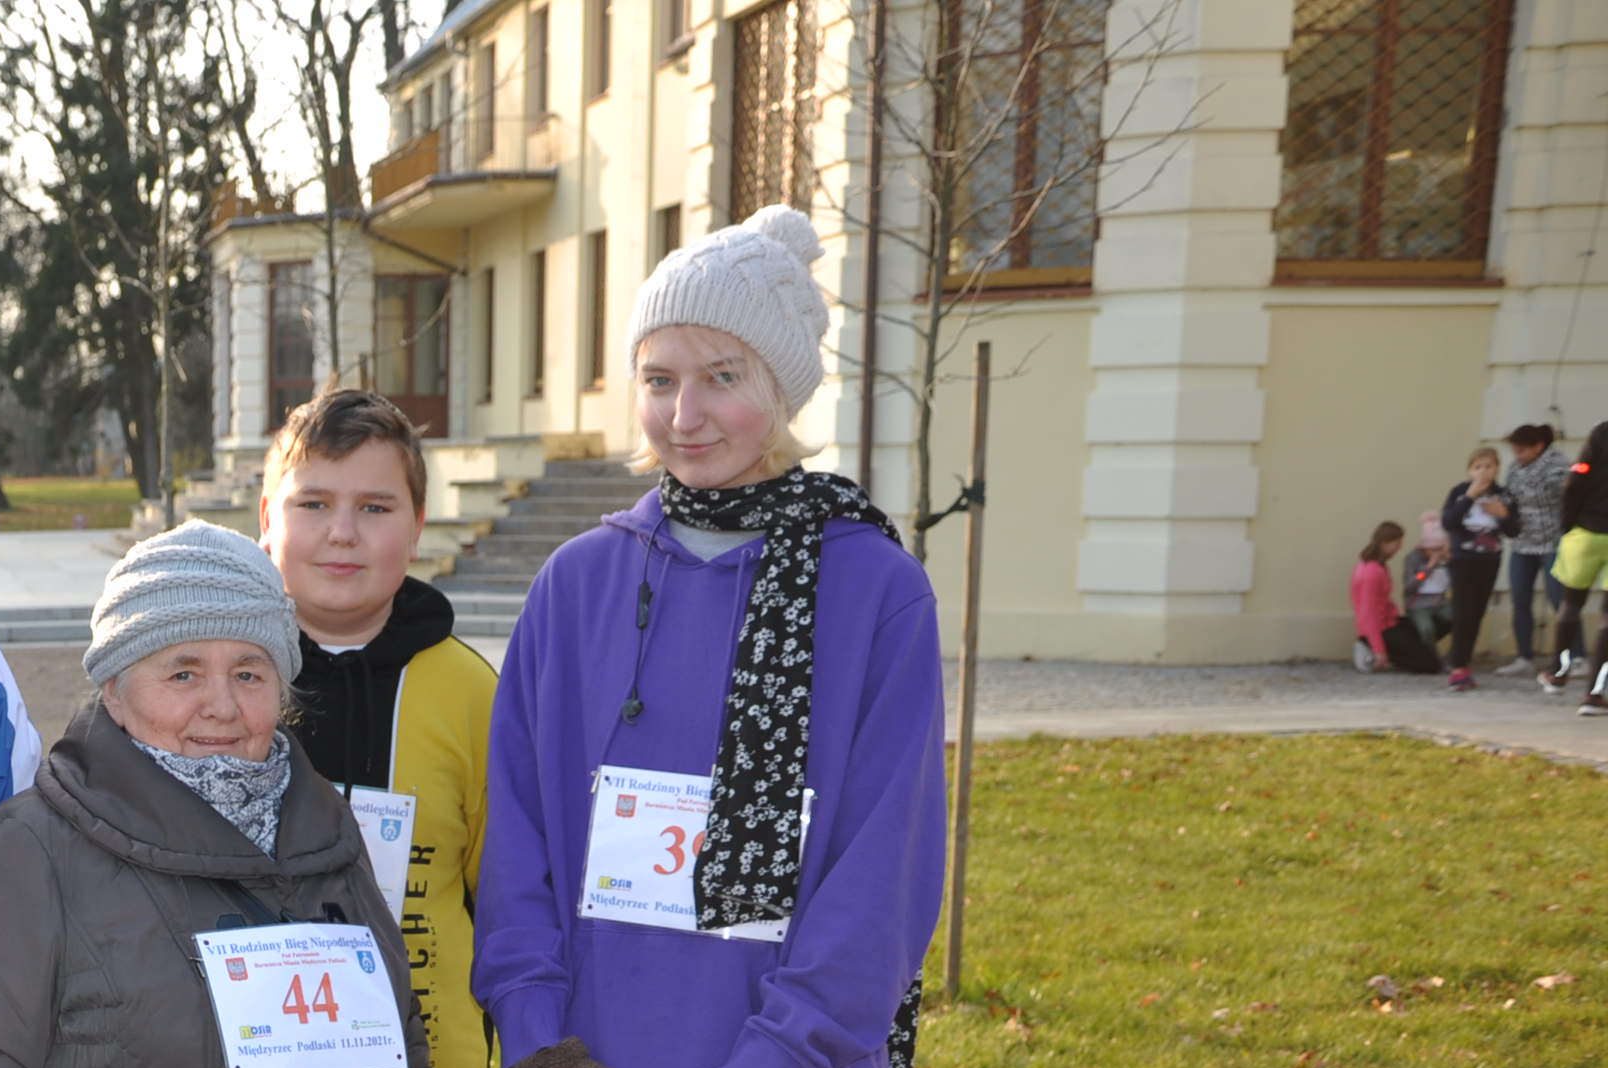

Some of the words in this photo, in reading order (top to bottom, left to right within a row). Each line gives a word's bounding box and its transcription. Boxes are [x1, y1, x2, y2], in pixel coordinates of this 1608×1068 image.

[629, 778, 682, 797] Rodzinny
[653, 825, 706, 878] 3
[590, 892, 649, 911] Międzyrzec
[654, 900, 696, 917] Podlask
[229, 941, 282, 954] Rodzinny
[285, 938, 308, 950] Bieg
[282, 972, 339, 1024] 44
[238, 1044, 292, 1058] Międzyrzec
[297, 1039, 336, 1052] Podlaski
